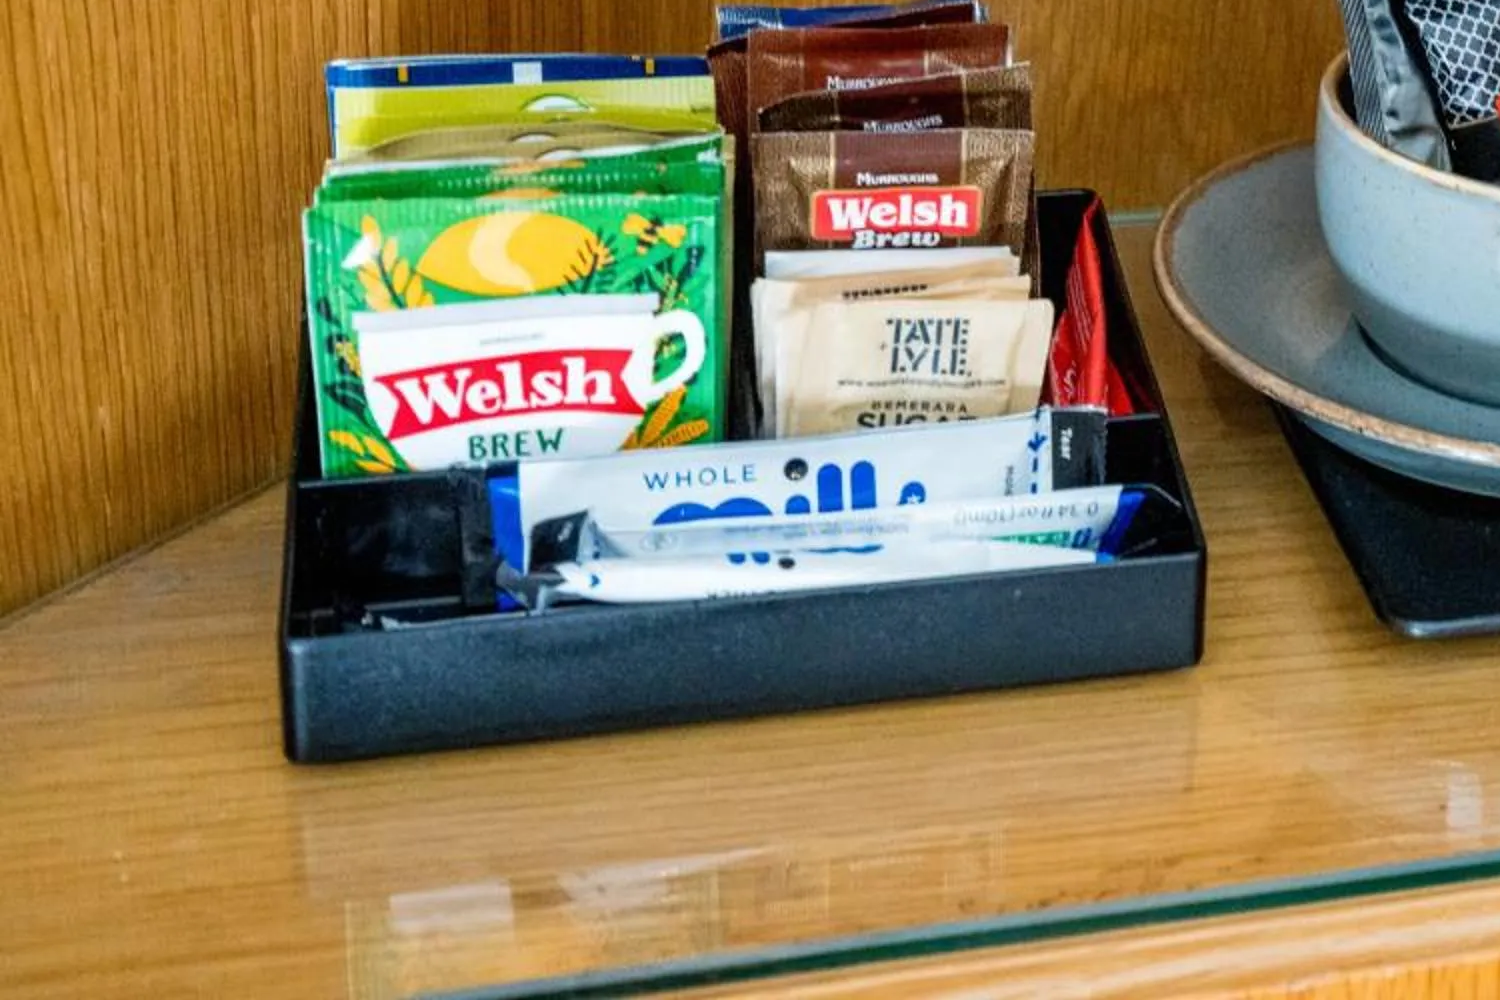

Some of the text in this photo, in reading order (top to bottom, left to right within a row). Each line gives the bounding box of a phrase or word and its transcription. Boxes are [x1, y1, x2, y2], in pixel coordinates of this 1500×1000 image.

[826, 194, 969, 231] Welsh
[851, 231, 941, 249] Brew
[886, 317, 970, 346] TATE
[392, 356, 616, 425] Welsh
[468, 427, 565, 461] BREW
[642, 463, 757, 491] WHOLE
